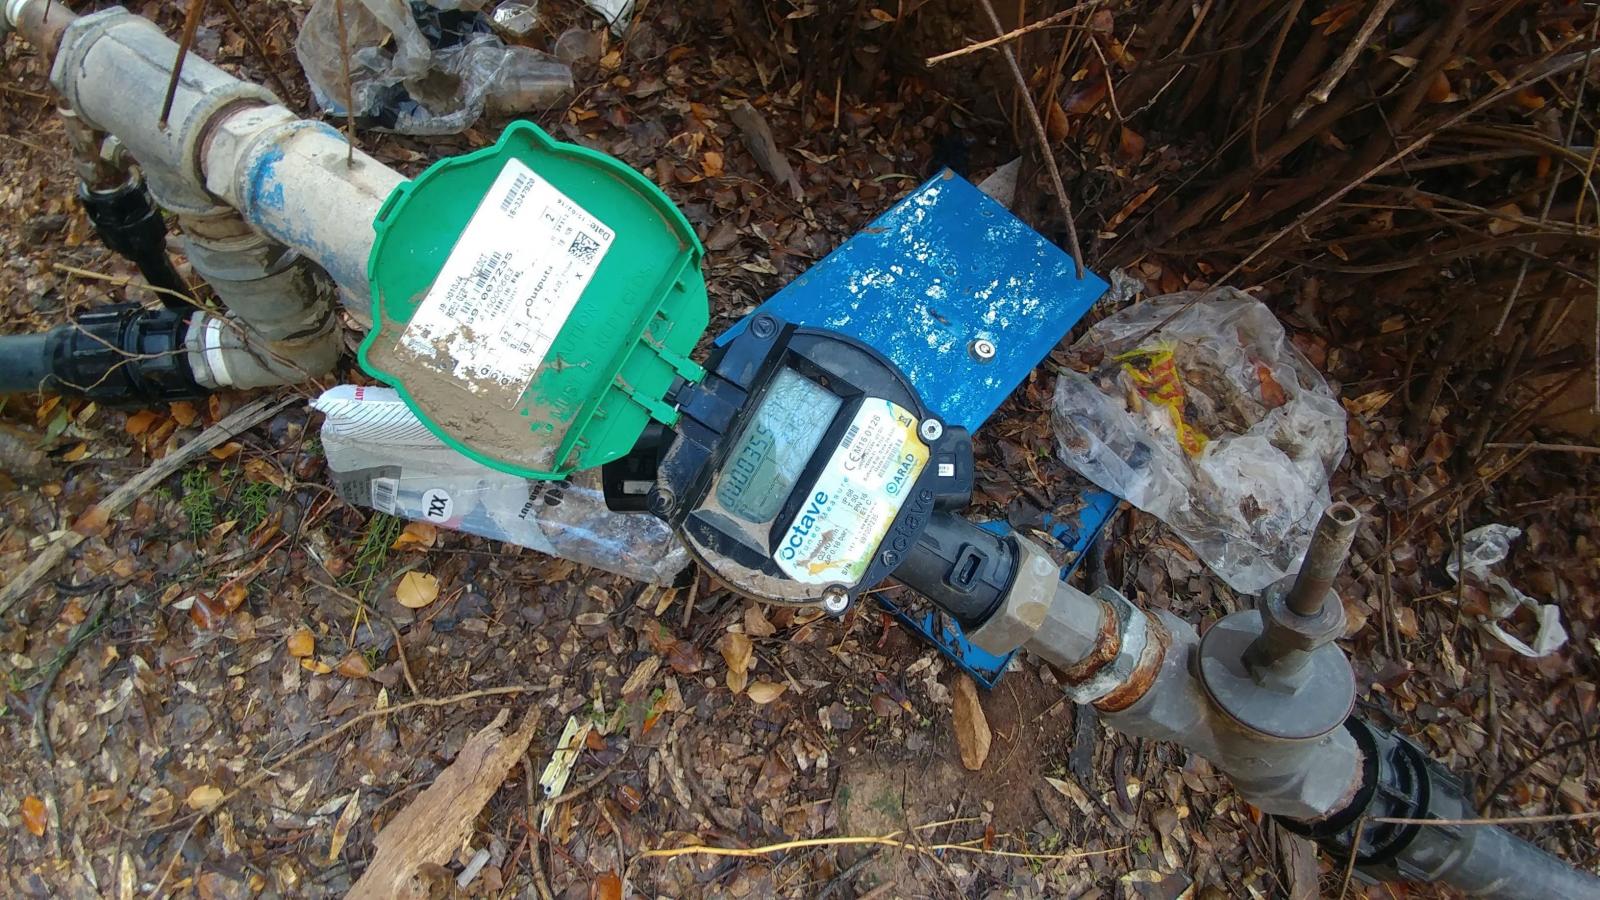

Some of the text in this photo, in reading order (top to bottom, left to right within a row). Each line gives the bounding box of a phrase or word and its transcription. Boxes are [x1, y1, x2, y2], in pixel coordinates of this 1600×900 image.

[545, 213, 554, 221] 2
[587, 220, 611, 242] Date:
[524, 265, 553, 307] Outputs
[893, 453, 914, 482] ARAD
[427, 493, 448, 519] XXL
[517, 500, 533, 520] OUT
[799, 525, 819, 555] Tuned
[821, 477, 848, 518] Measure
[778, 490, 827, 560] octave
[881, 488, 932, 567] octave
